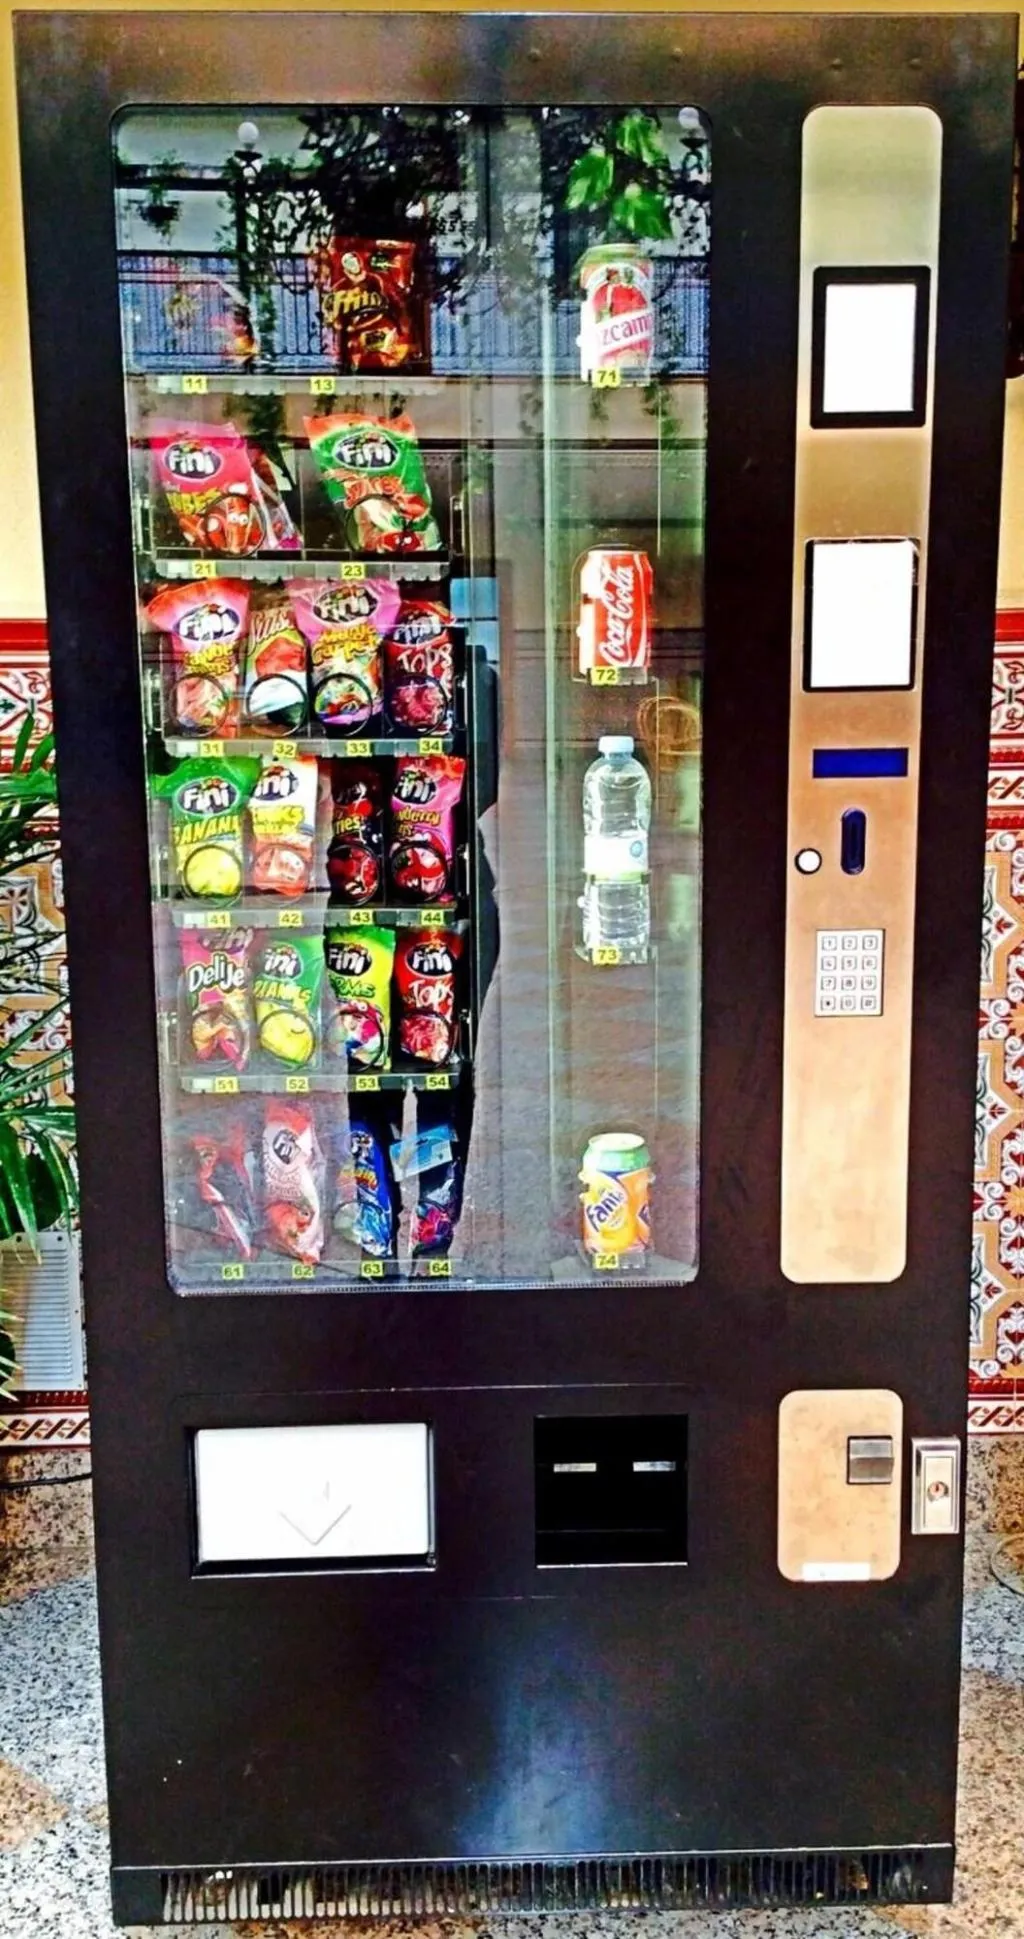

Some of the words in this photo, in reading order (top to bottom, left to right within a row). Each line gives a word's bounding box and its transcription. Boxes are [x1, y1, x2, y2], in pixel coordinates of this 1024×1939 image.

[597, 370, 616, 383] 71
[185, 378, 203, 390] 11
[314, 379, 333, 390] 13
[341, 436, 391, 466] Fini
[169, 445, 214, 475] Fini
[195, 564, 212, 576] 21
[344, 566, 362, 576] 23
[320, 590, 370, 622] Fini
[179, 606, 236, 640] Fini
[596, 670, 616, 681] 72
[203, 743, 219, 754] 31
[277, 743, 293, 755] 32
[350, 742, 368, 753] 33
[422, 741, 439, 752] 34
[183, 780, 230, 812] Fini
[211, 915, 226, 925] 41
[281, 913, 299, 923] 42
[353, 912, 370, 922] 43
[424, 912, 441, 923] 44
[329, 945, 367, 974] Fini
[412, 946, 452, 973] Fini
[598, 950, 616, 961] 73
[217, 1080, 234, 1090] 51
[289, 1079, 306, 1089] 52
[358, 1078, 375, 1088] 53
[429, 1077, 446, 1087] 54
[224, 1268, 240, 1276] 61
[295, 1267, 311, 1276] 62
[364, 1266, 380, 1275] 63
[432, 1264, 448, 1273] 64
